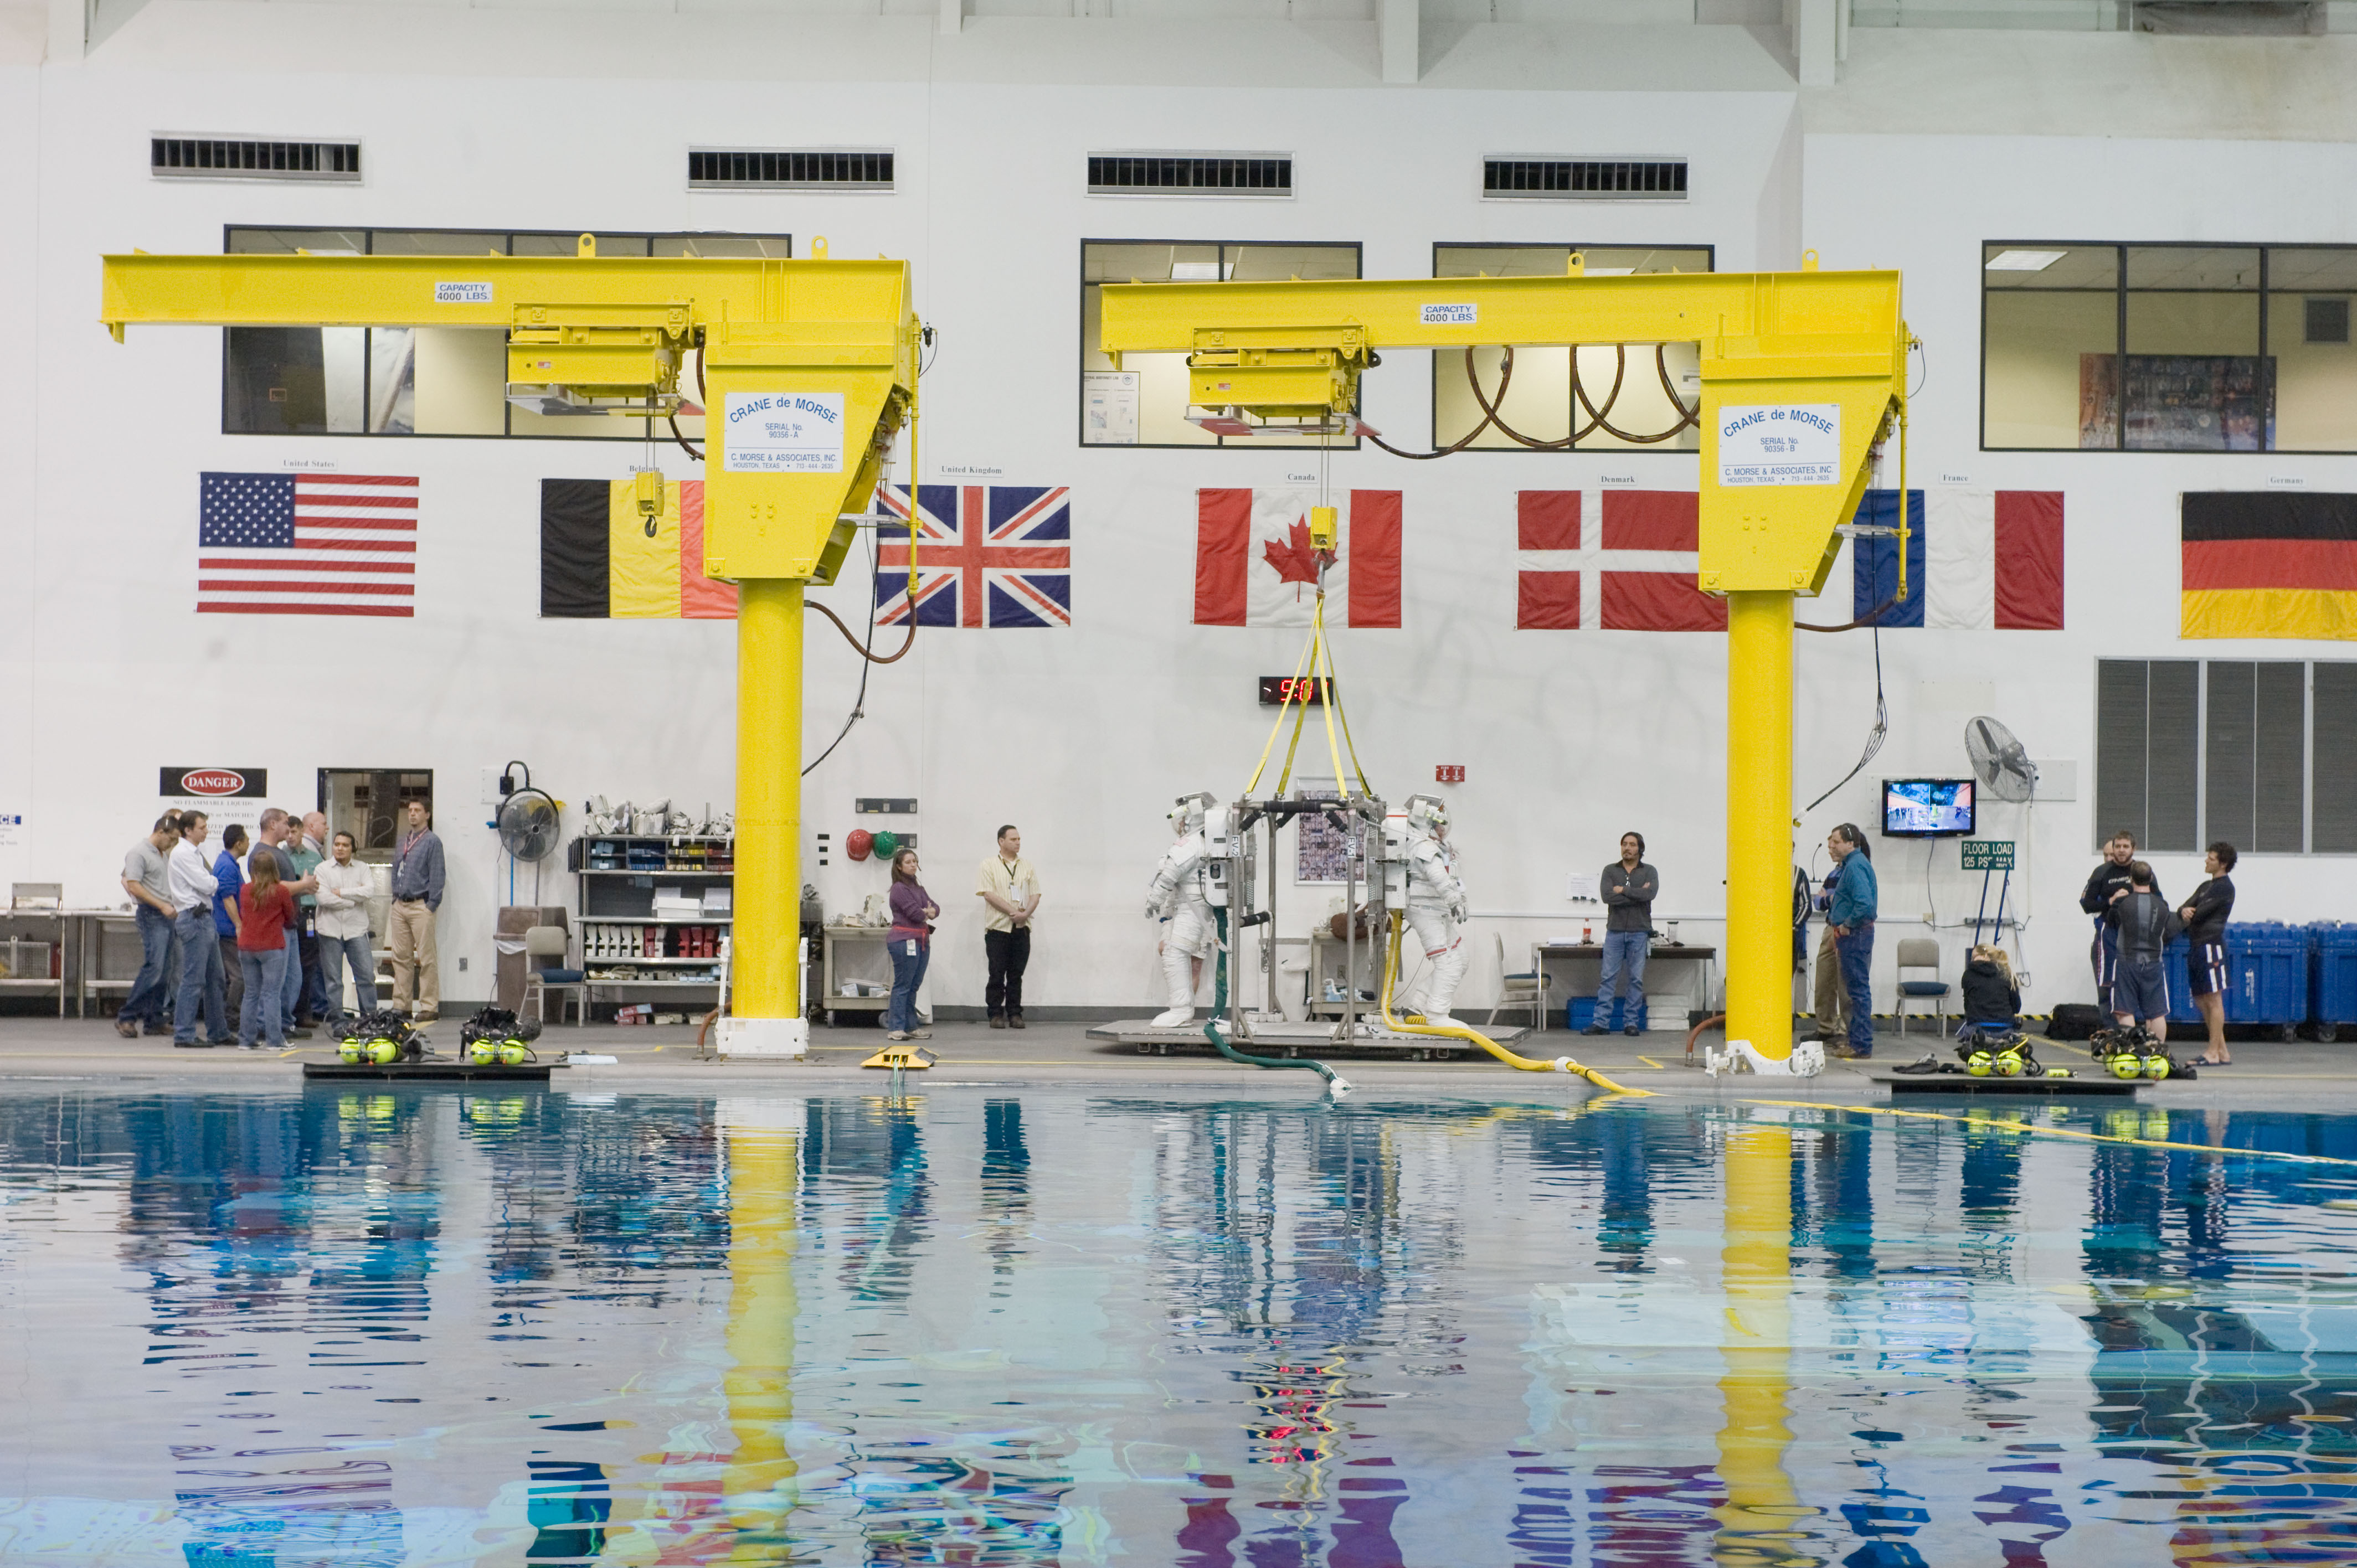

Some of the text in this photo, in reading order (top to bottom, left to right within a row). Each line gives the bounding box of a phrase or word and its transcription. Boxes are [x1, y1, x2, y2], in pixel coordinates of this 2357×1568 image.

[466, 292, 490, 300] LBS.
[1424, 313, 1448, 322] 4000
[730, 396, 838, 424] CRANE de MORSE
[1724, 409, 1834, 437] CRANE de MORSE
[776, 453, 822, 462] ASSOCIATES,
[970, 466, 1002, 474] Kingdom
[1771, 466, 1818, 474] ASSOCIATES,
[2271, 477, 2303, 486] Germany
[188, 777, 238, 788] DANGER
[1963, 843, 2013, 854] FLOOR LOAD
[1963, 857, 1975, 868] 125
